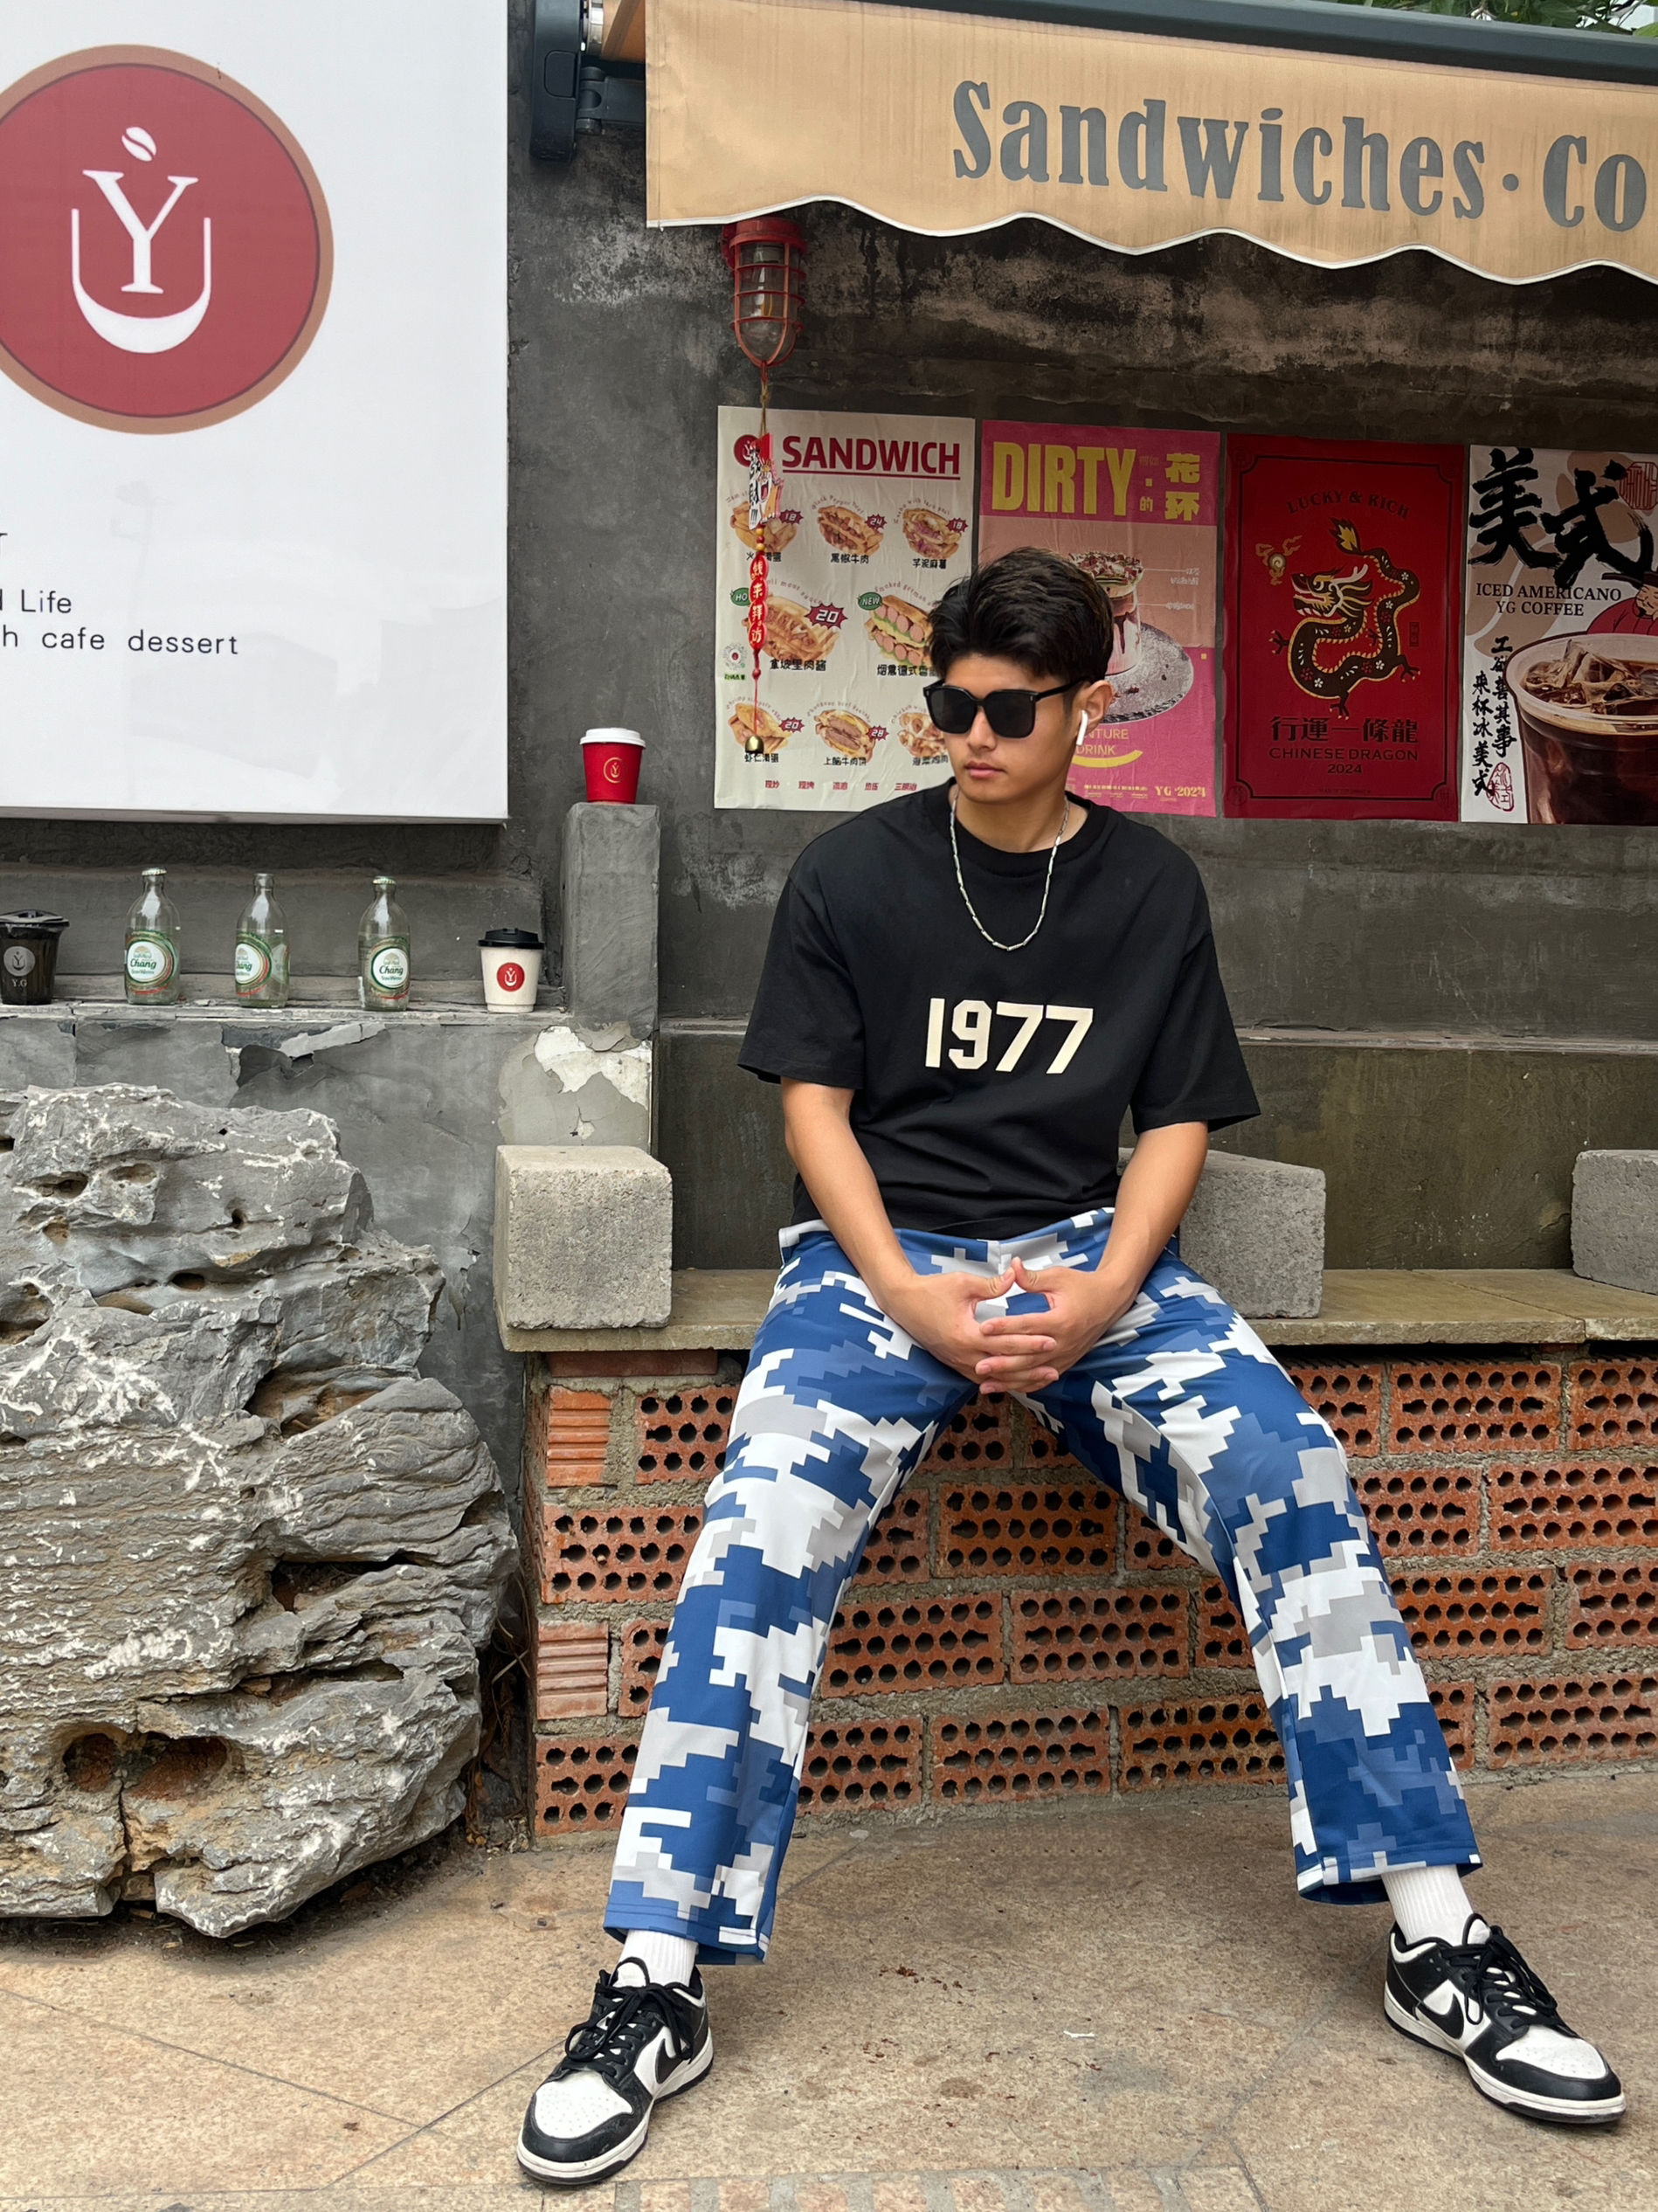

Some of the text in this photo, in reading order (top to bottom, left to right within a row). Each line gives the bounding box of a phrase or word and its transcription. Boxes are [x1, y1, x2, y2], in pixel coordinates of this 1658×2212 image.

[952, 79, 1486, 221] Sandwiches
[782, 435, 961, 475] SANDWICH
[991, 441, 1136, 516] DIRTY
[1286, 490, 1411, 519] LUCKY & RICH
[1476, 583, 1622, 601] ICED AMERICANO
[21, 589, 73, 613] Life
[861, 597, 881, 606] NEW
[1496, 600, 1585, 617] YG COFFEE
[816, 611, 839, 623] 20
[41, 626, 106, 650] cafe
[128, 628, 238, 655] dessert
[785, 722, 799, 730] 20
[1076, 744, 1116, 756] DRINK
[1268, 747, 1419, 761] CHINESE DRAGON
[1326, 763, 1363, 774] 2024
[1154, 785, 1172, 797] YG
[129, 957, 157, 970] Chang
[378, 964, 404, 976] Chang
[11, 978, 28, 987] Y.G
[924, 997, 1094, 1075] 1977
